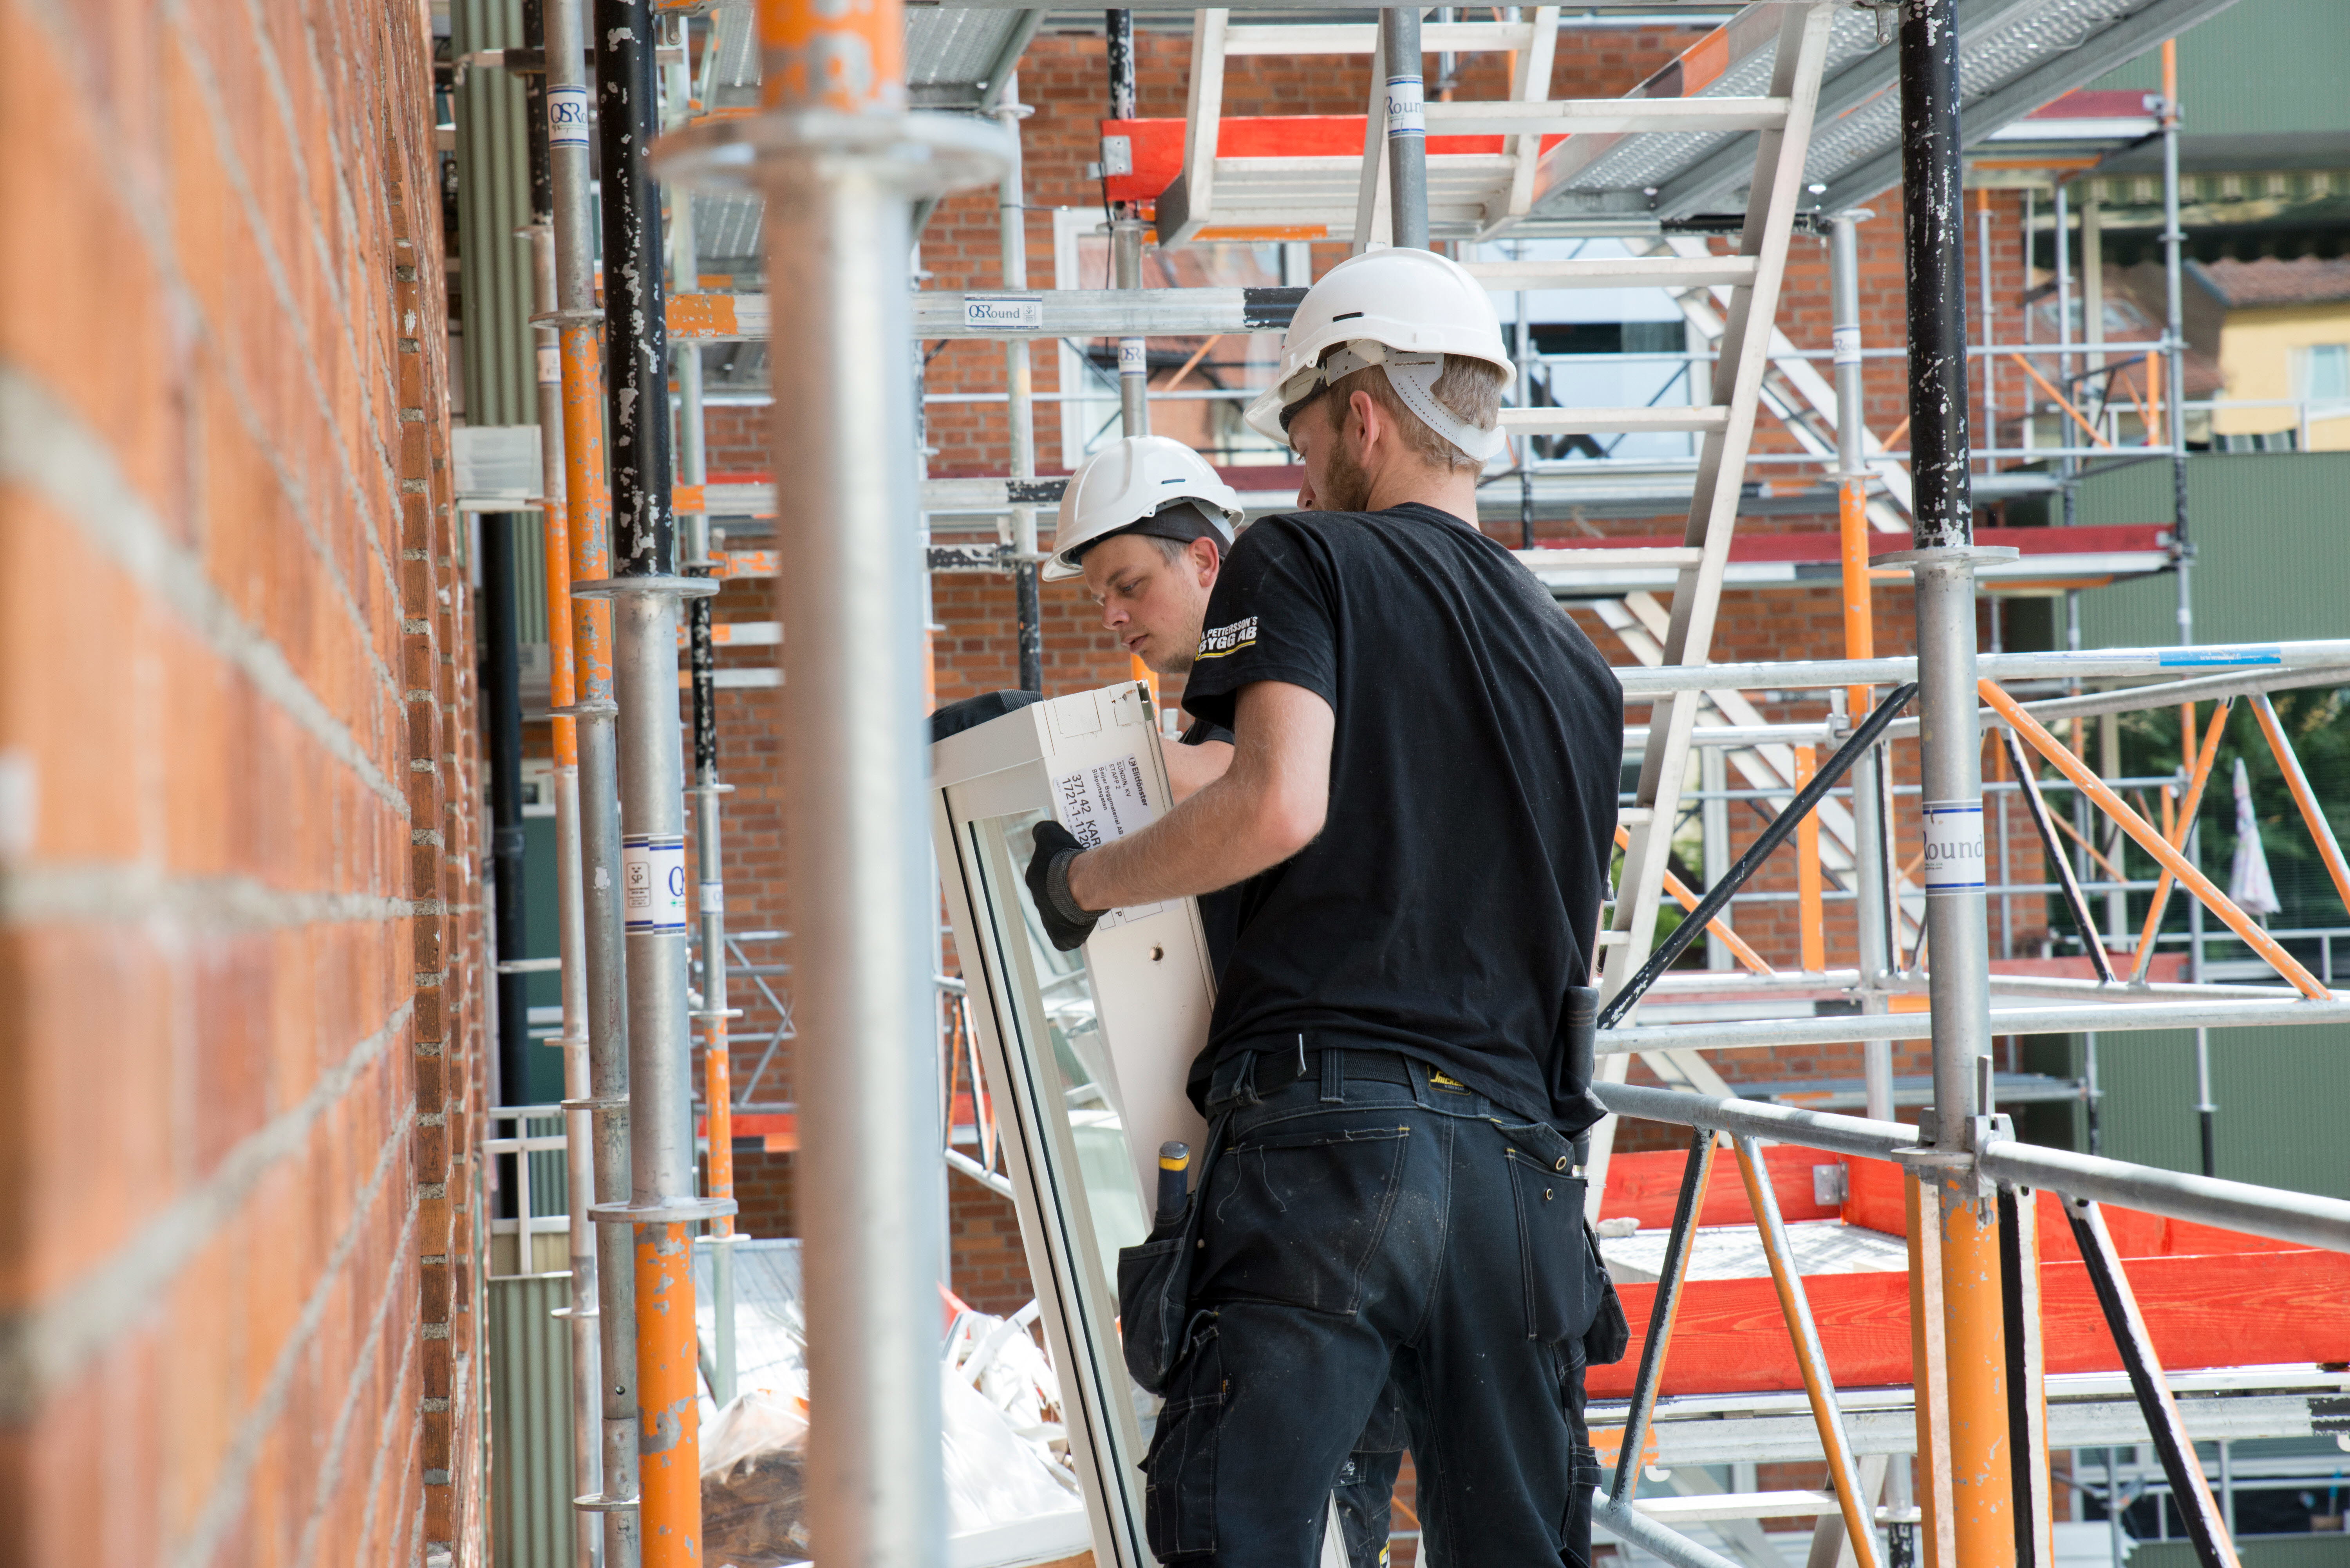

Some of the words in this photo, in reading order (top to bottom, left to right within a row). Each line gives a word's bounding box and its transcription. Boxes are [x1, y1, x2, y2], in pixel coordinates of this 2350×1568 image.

[969, 304, 1020, 318] QSRound
[1198, 633, 1236, 653] BYGG
[1237, 626, 1257, 642] AB
[1092, 769, 1107, 811] Blåportsgatan
[1109, 764, 1119, 784] ETAPP
[1116, 761, 1128, 788] SUNDIN,
[1124, 788, 1132, 797] KV
[1132, 766, 1148, 806] Elitfönster
[1062, 778, 1091, 849] 1721-1-1120
[1072, 774, 1086, 795] 371
[1080, 799, 1091, 814] 42
[1086, 820, 1101, 846] KAR
[1099, 767, 1107, 784] Beijer
[1104, 785, 1120, 825] Byggmaterial
[1117, 825, 1124, 835] AB
